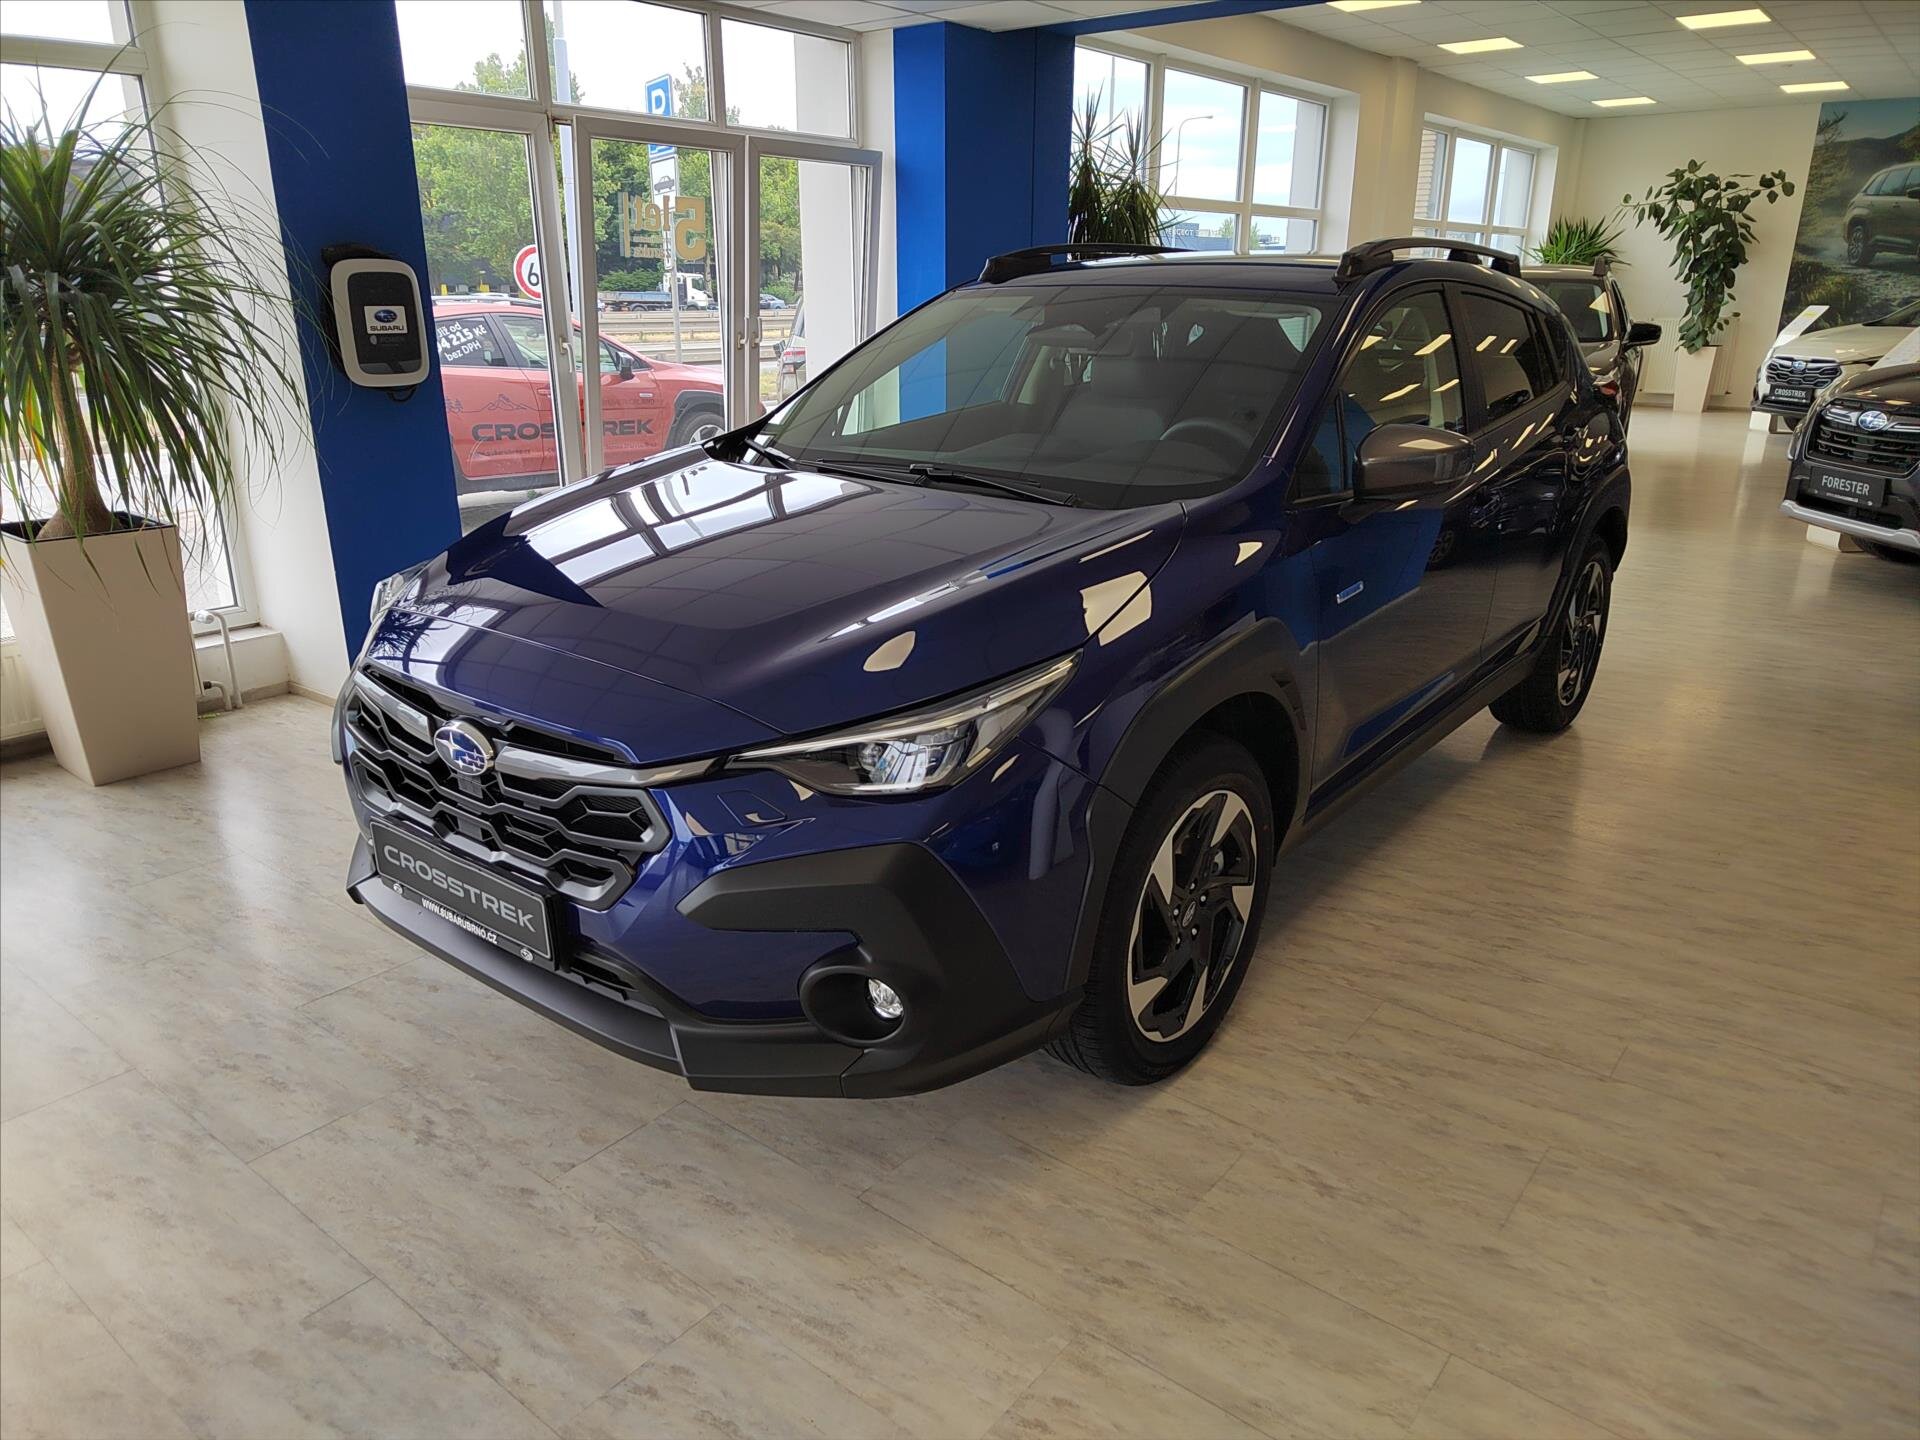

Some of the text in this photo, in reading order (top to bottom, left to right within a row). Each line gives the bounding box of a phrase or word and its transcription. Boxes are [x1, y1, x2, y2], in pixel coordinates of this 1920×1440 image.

[651, 88, 667, 115] P
[369, 324, 405, 332] SUBARU
[448, 327, 474, 346] 215
[450, 321, 462, 334] od
[444, 339, 482, 362] bez DPH
[1774, 388, 1807, 398] CROSSTREK
[1821, 475, 1870, 496] FORESTER
[383, 845, 536, 933] CROSSTREK
